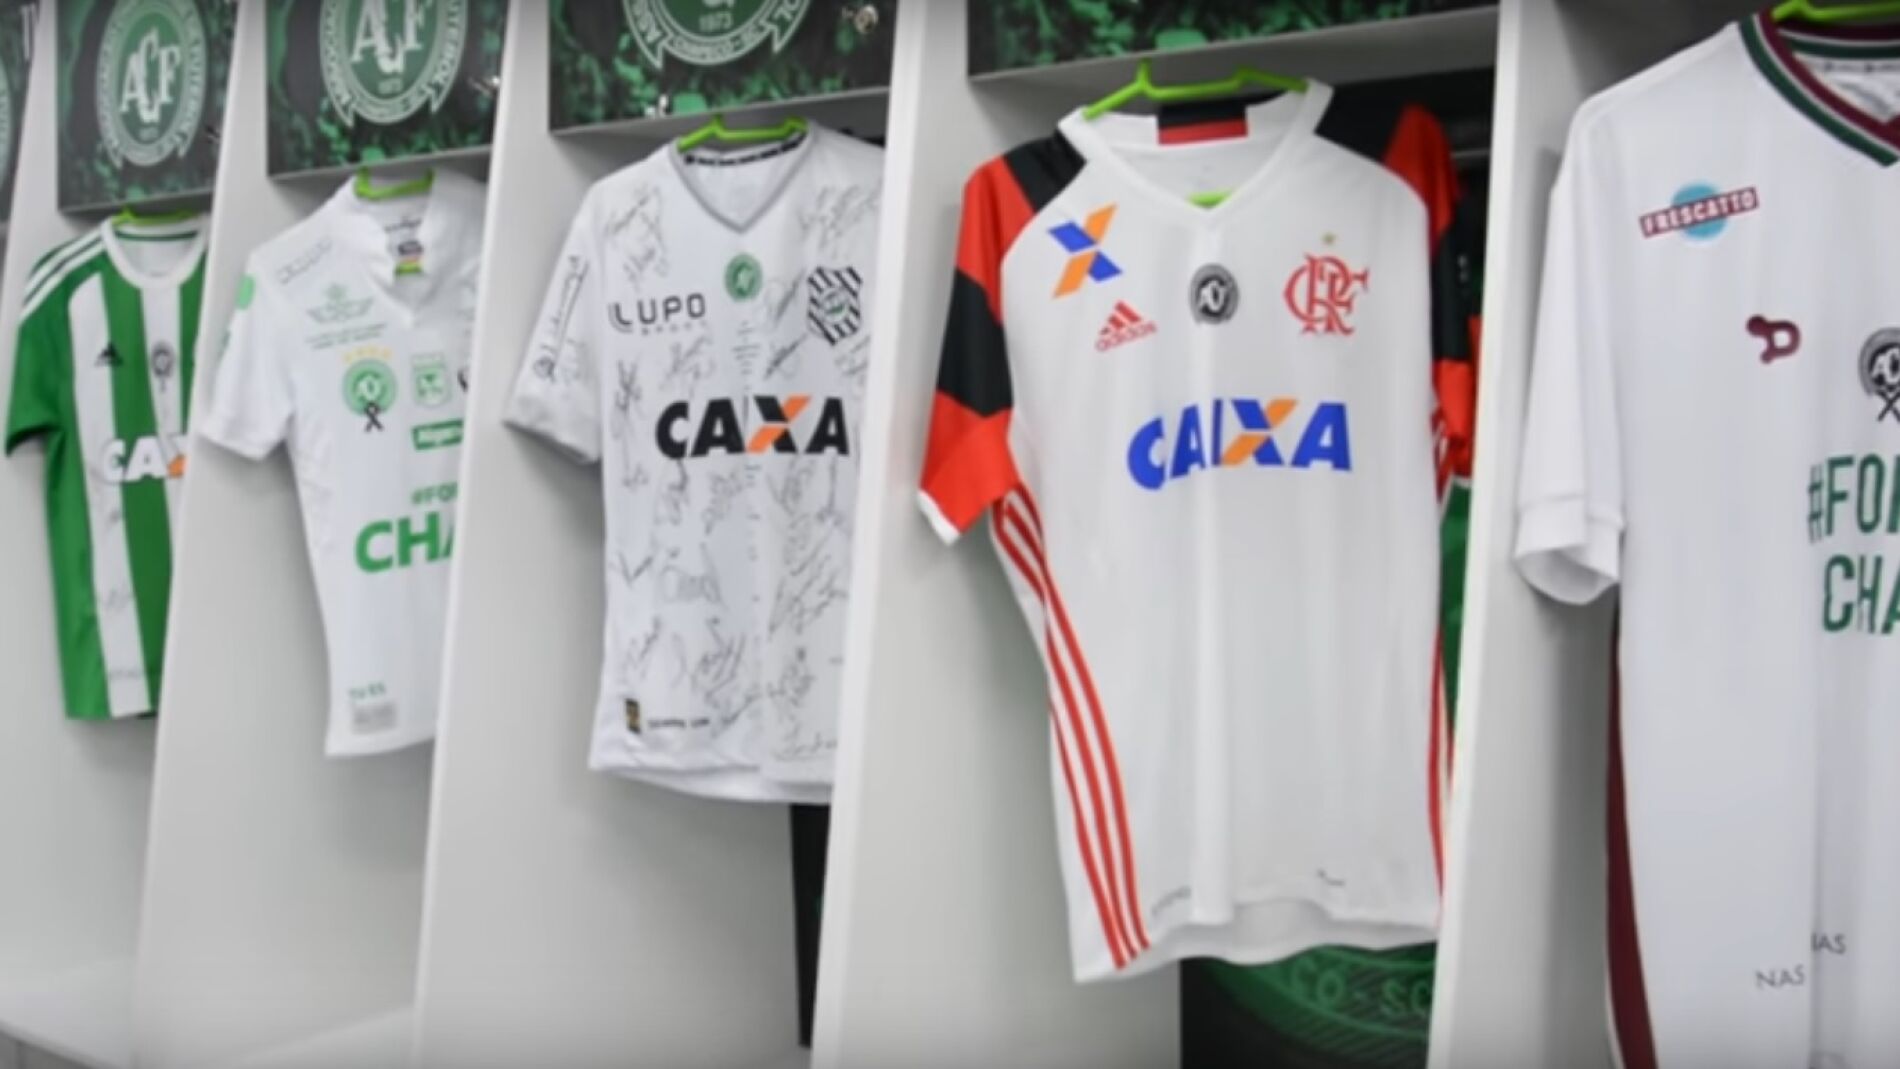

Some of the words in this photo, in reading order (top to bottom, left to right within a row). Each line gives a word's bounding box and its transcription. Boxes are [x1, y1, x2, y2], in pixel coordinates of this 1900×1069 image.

[1640, 187, 1759, 238] FRESCATTO
[607, 292, 706, 334] LUPO
[1096, 321, 1158, 352] adidas
[1127, 398, 1352, 490] CAIXA
[1755, 963, 1805, 990] NAS
